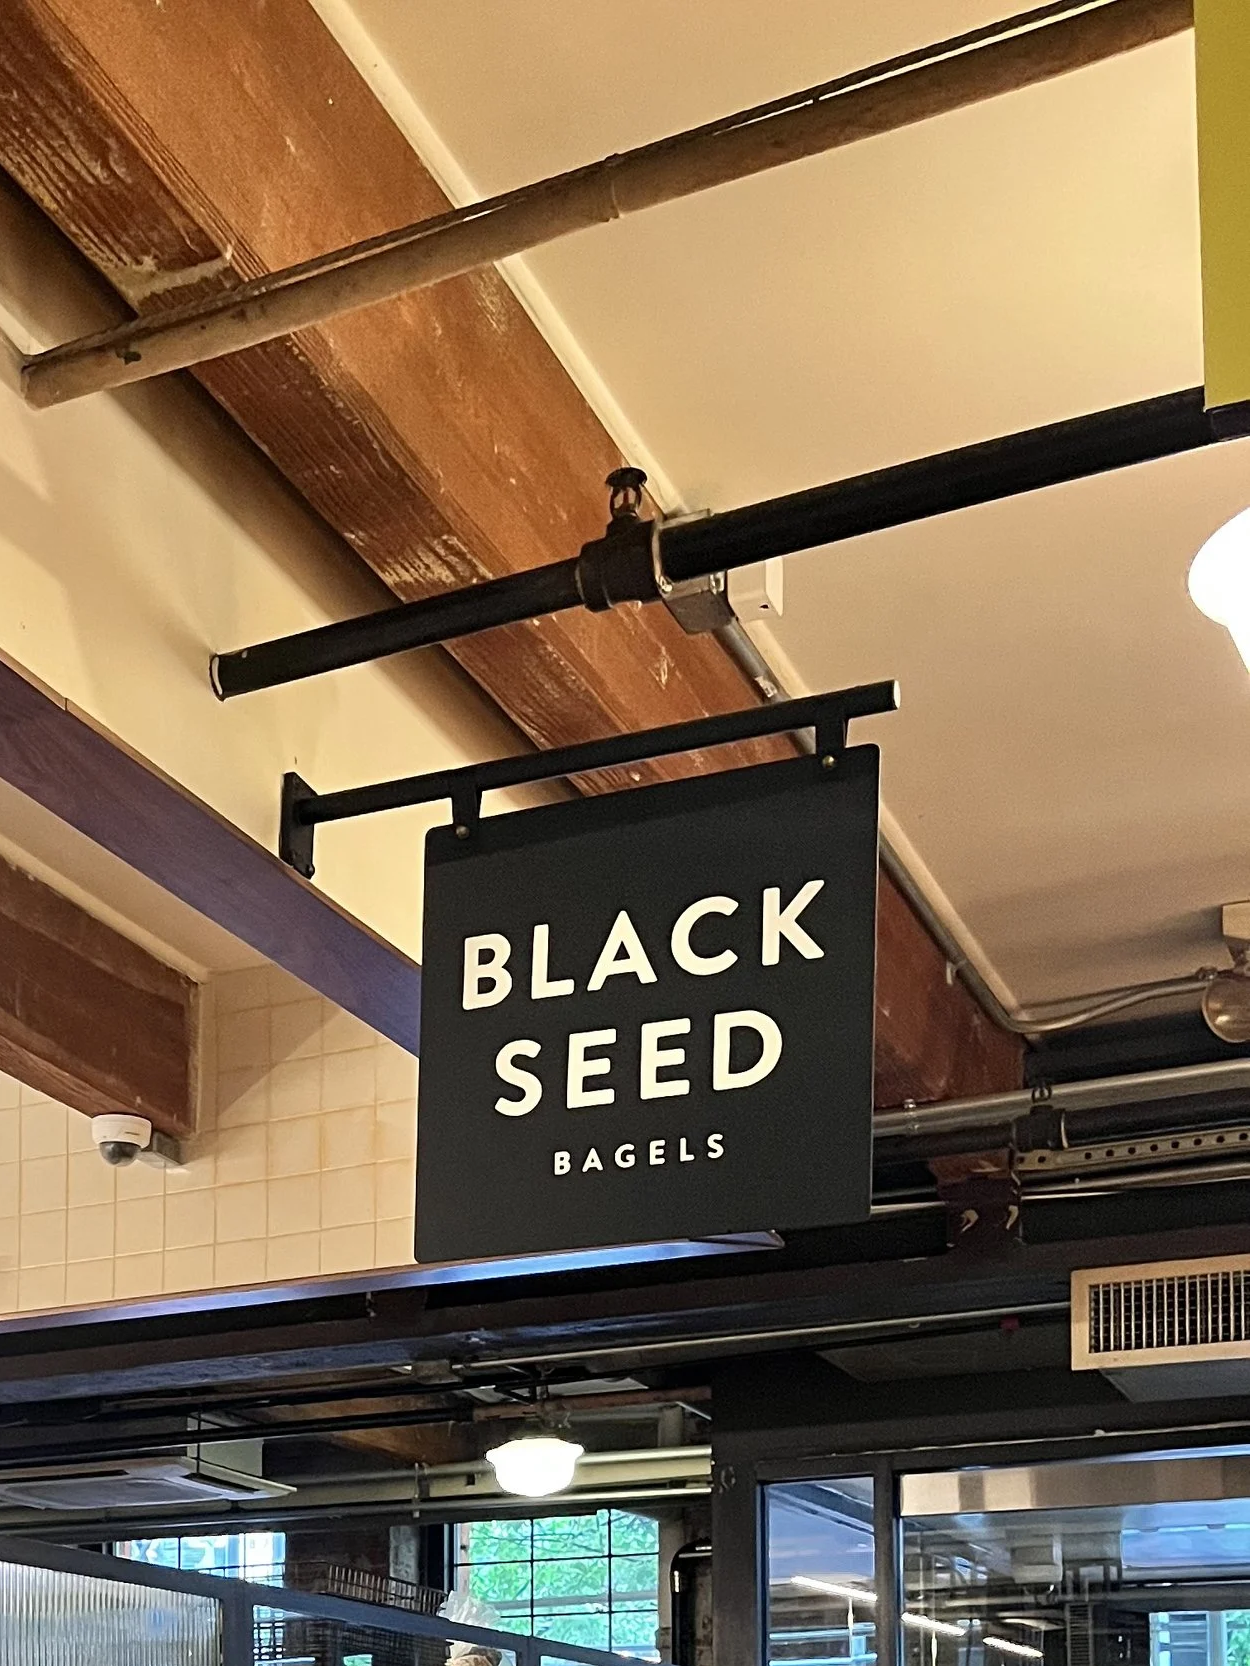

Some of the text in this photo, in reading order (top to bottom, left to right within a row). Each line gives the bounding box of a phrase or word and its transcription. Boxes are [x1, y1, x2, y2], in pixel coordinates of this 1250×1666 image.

[462, 879, 825, 1011] BLACK
[494, 1009, 783, 1117] SEED
[554, 1133, 725, 1176] BAGELS
